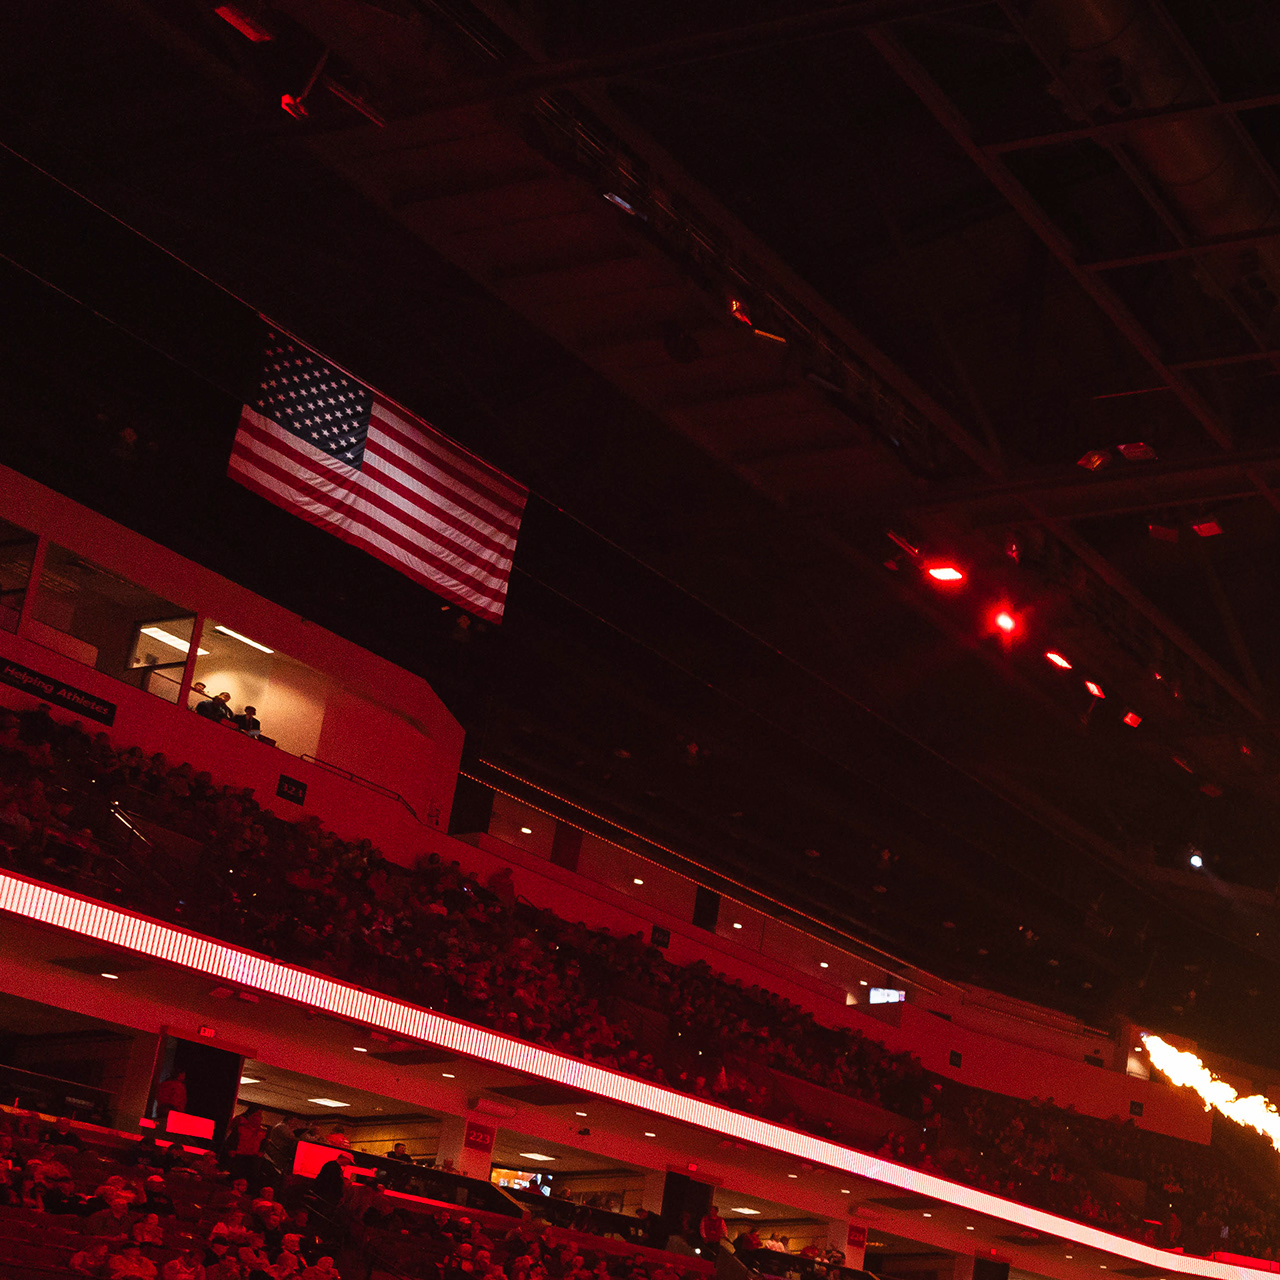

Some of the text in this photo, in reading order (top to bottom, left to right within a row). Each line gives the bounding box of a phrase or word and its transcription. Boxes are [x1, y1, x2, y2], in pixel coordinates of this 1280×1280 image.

[4, 665, 109, 716] Helping Athletes
[468, 1130, 491, 1145] 223
